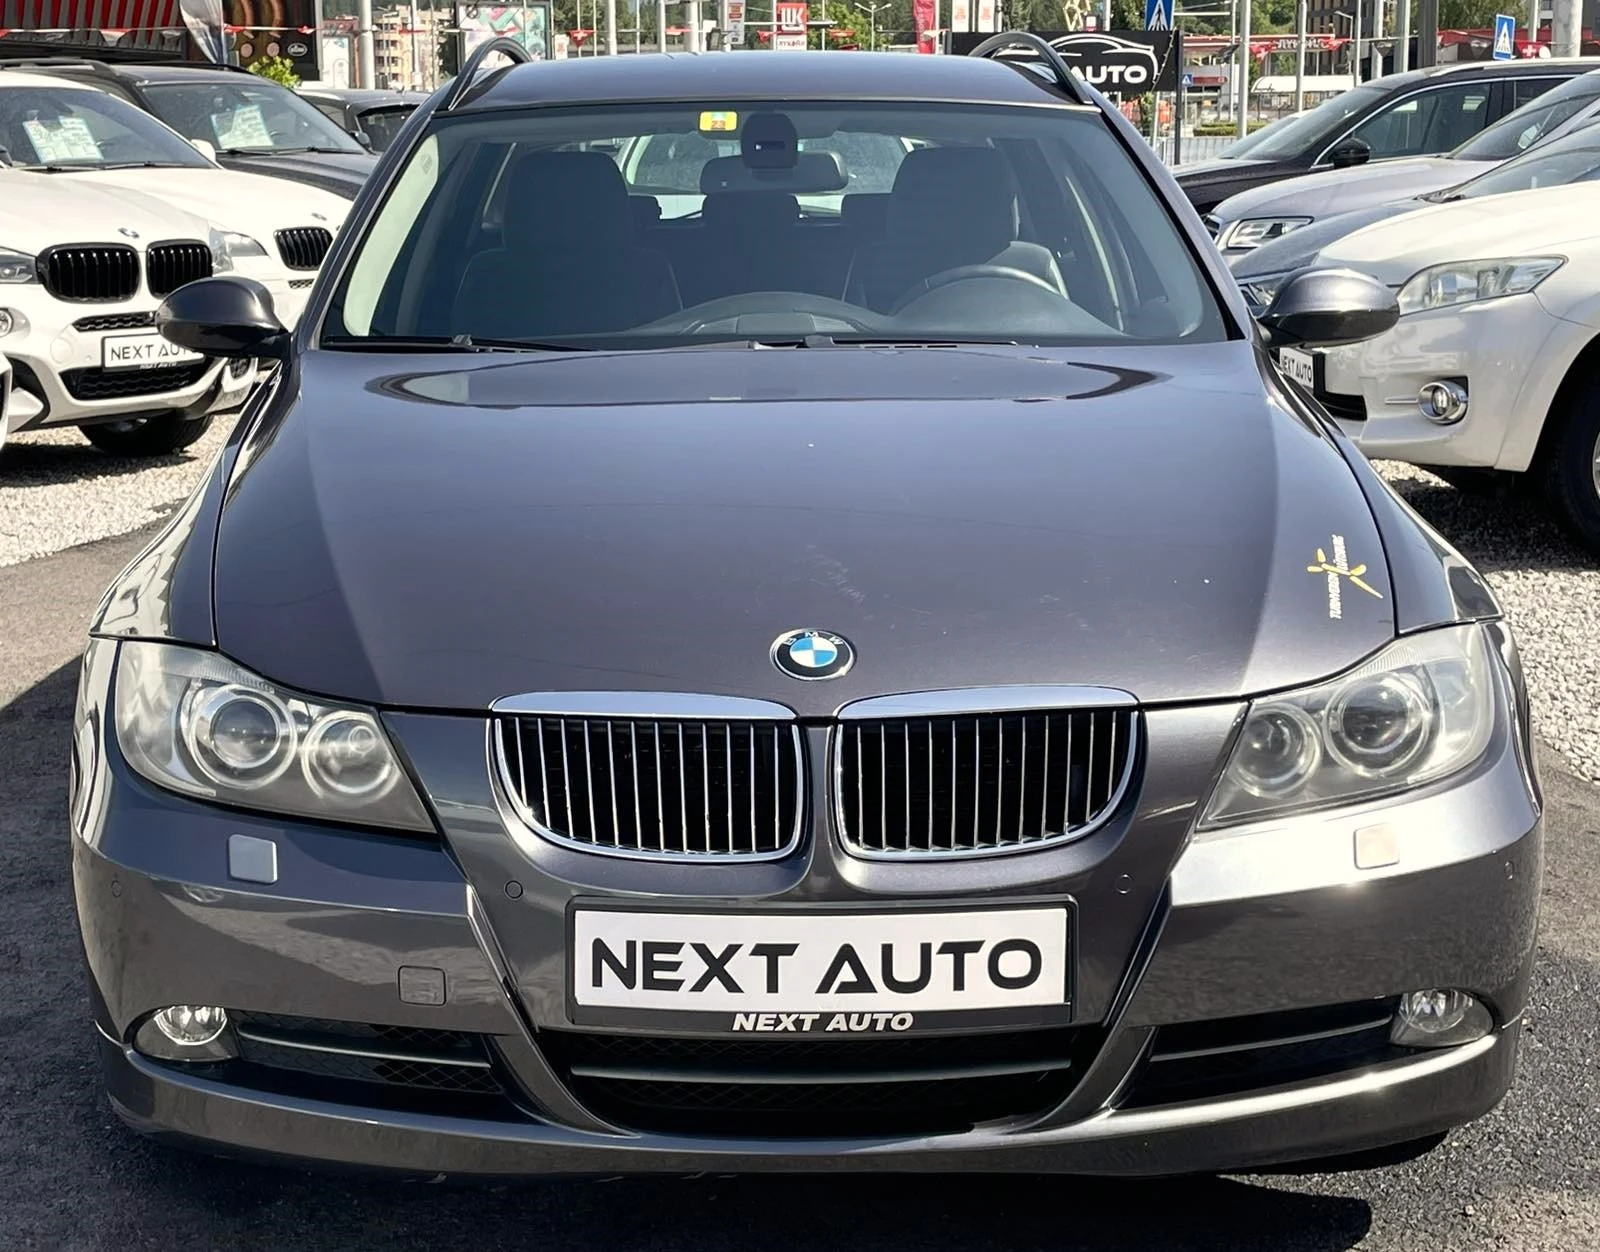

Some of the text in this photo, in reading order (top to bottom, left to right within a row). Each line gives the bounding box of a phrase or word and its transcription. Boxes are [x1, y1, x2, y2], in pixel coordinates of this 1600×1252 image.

[1070, 65, 1147, 84] AUTO
[111, 345, 154, 360] NEXT
[592, 937, 1042, 995] NEXT AUTO
[731, 1012, 914, 1032] NEXT AUTO
